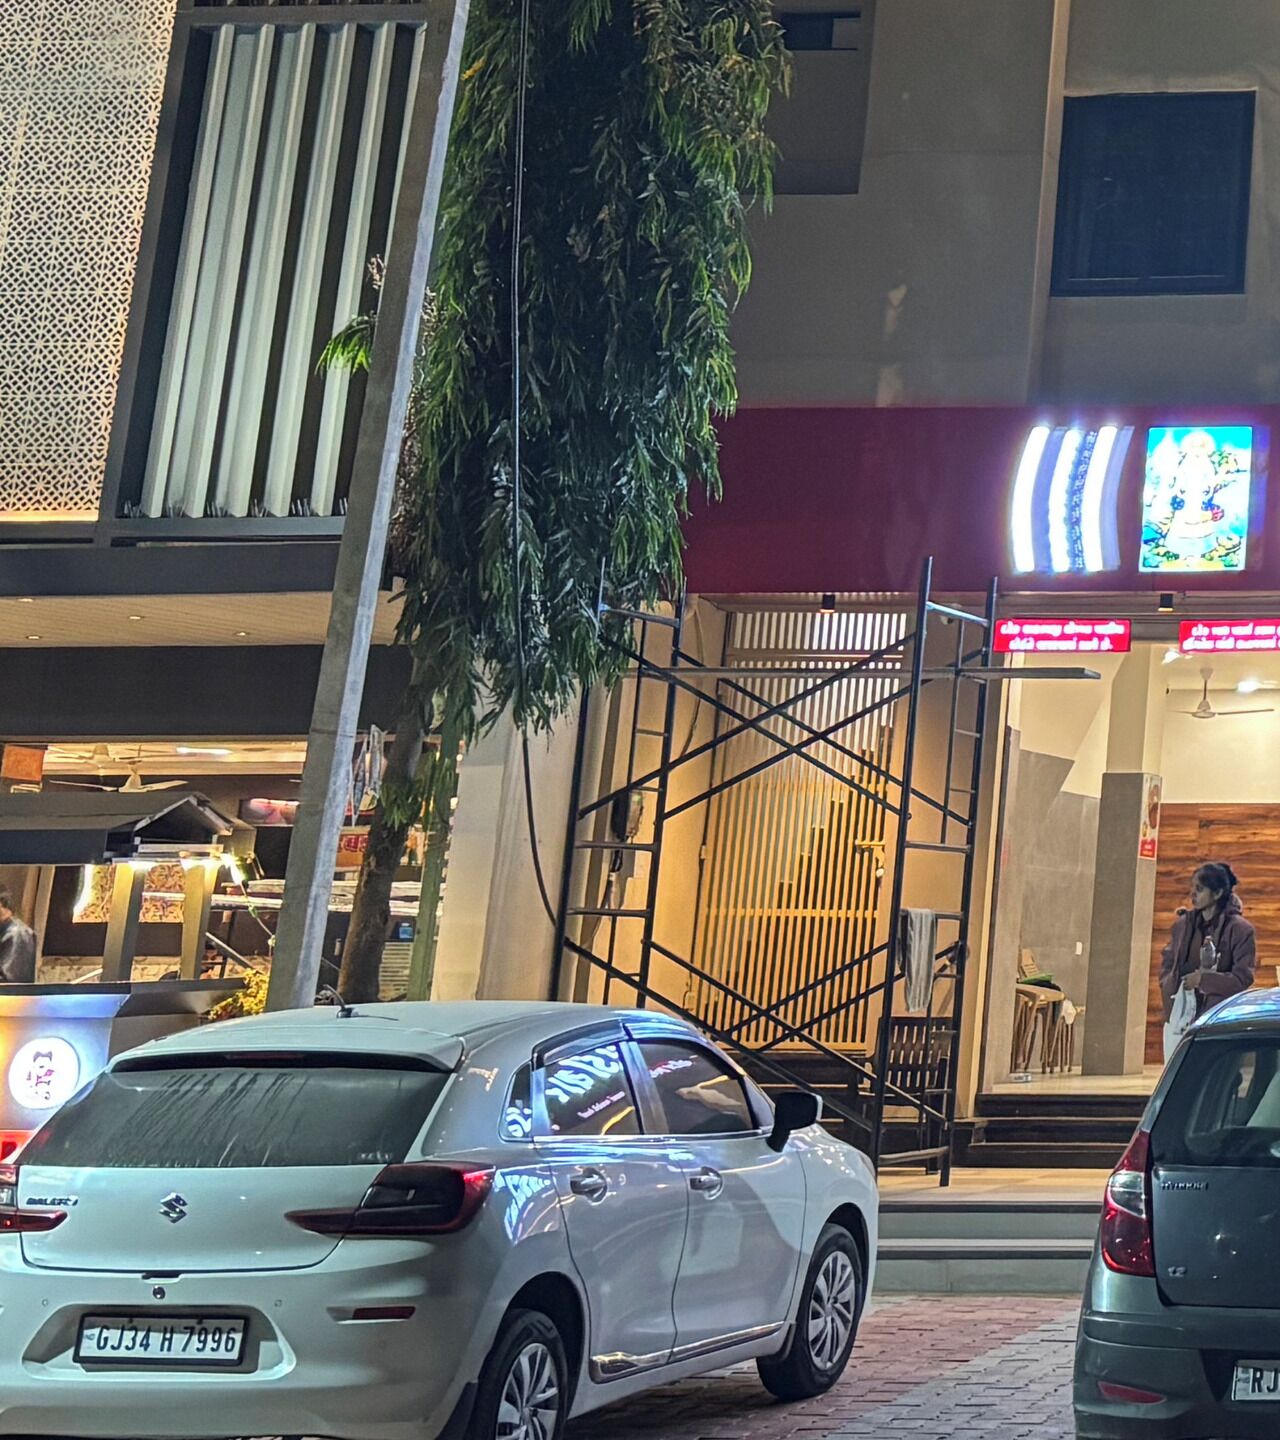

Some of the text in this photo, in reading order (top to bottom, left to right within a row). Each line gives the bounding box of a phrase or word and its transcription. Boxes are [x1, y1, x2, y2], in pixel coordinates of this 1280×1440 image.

[96, 1324, 236, 1353] GJ34 H 7996
